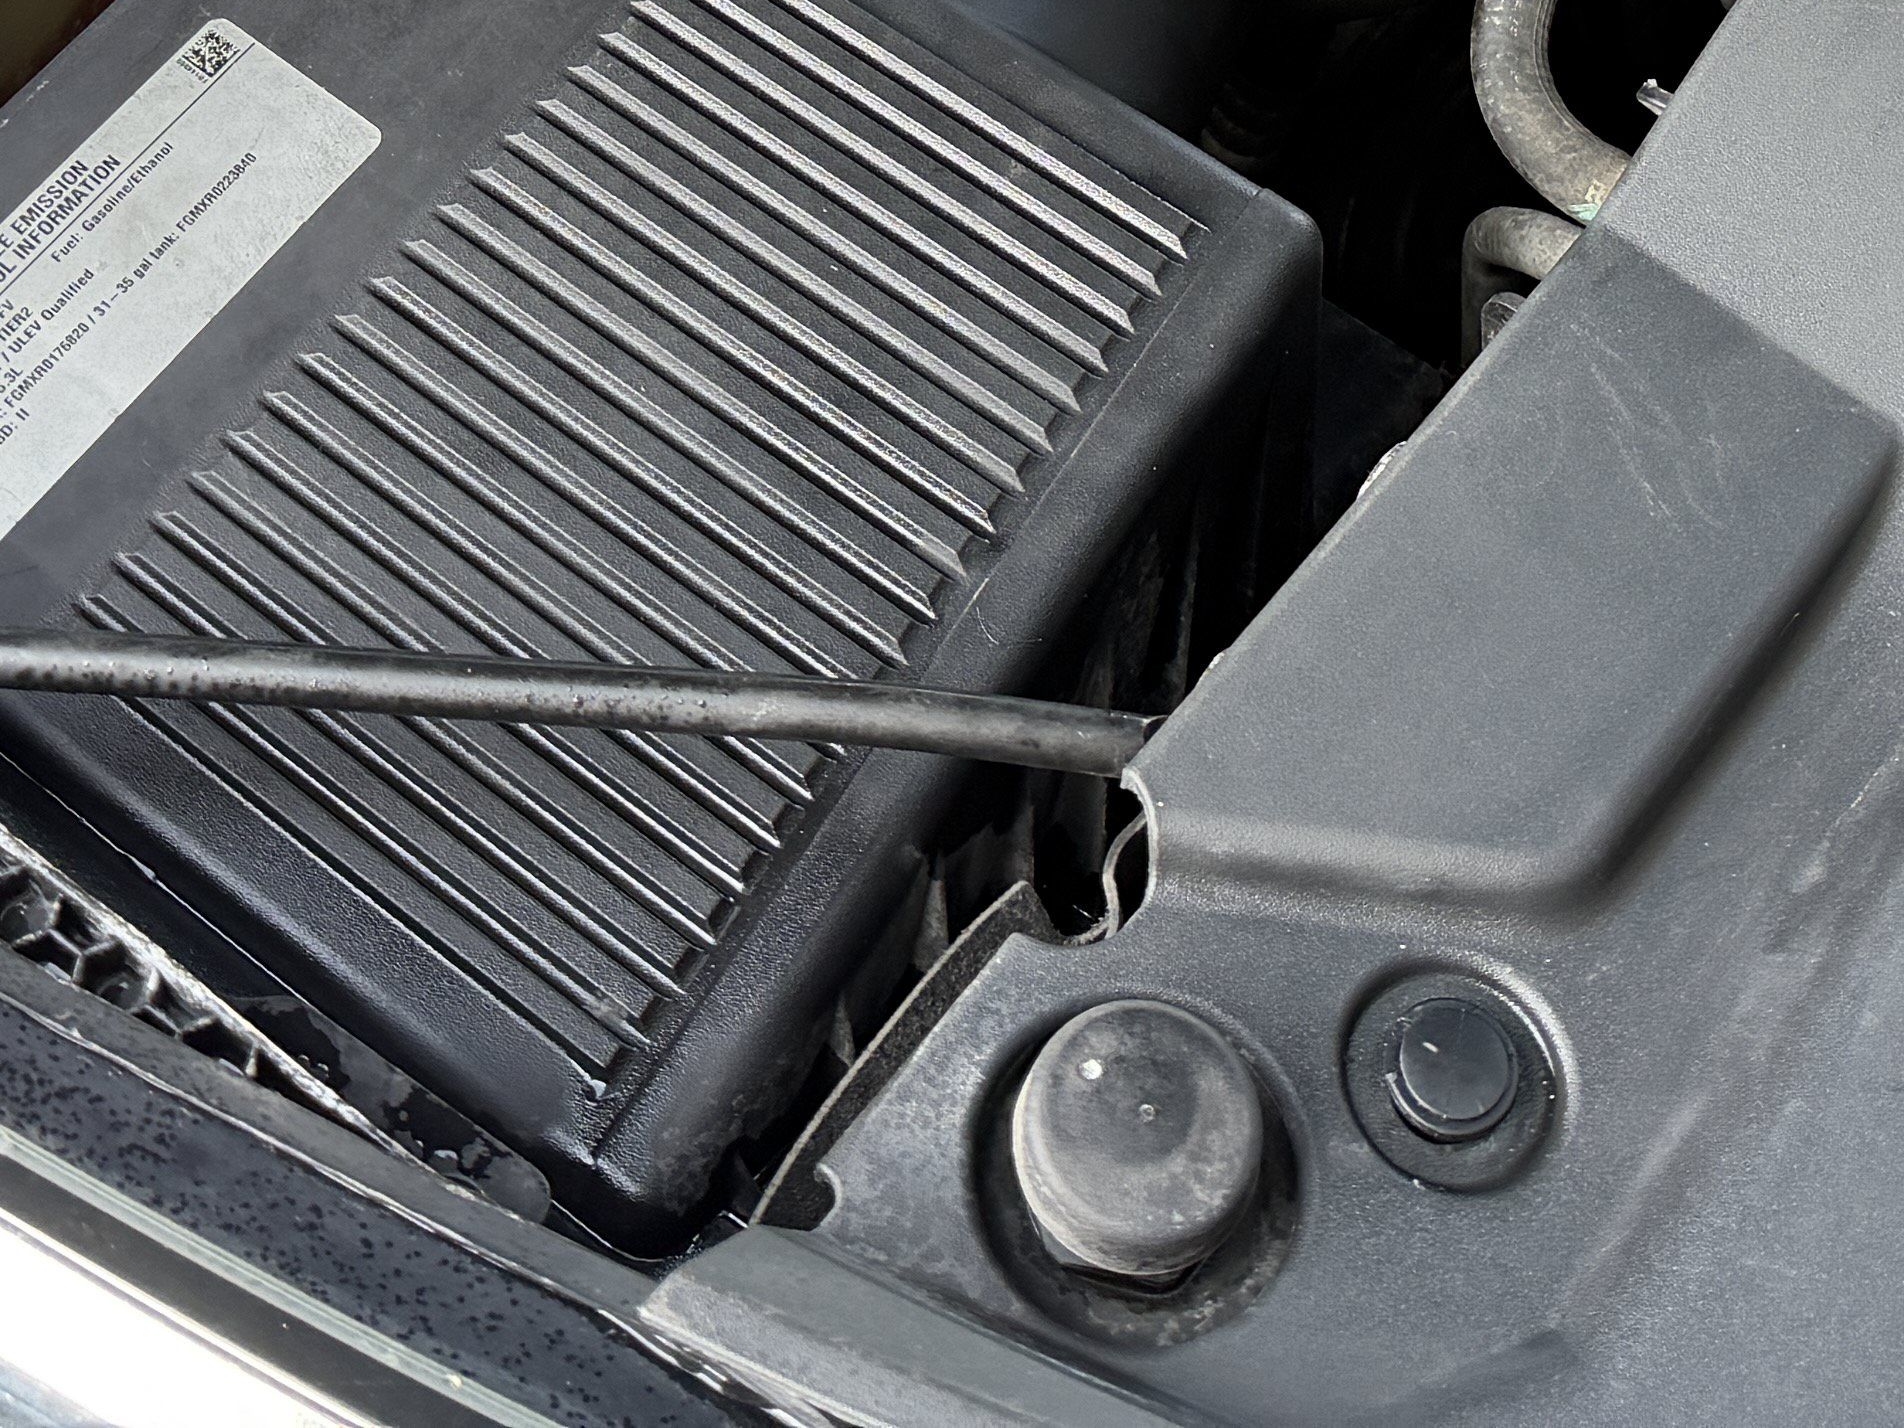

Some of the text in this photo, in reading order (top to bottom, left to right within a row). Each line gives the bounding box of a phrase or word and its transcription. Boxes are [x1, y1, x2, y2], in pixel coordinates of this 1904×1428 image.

[9, 159, 89, 235] EMISSION
[11, 153, 121, 260] INFORMATION
[50, 141, 173, 262] Fuel: Gasoline/Ethanol
[0, 350, 10, 363] /
[6, 319, 41, 353] ULEV
[39, 267, 94, 321] Qualified
[86, 313, 96, 324] /
[132, 257, 153, 279] gal
[148, 231, 180, 260] tank:
[14, 407, 30, 421] II
